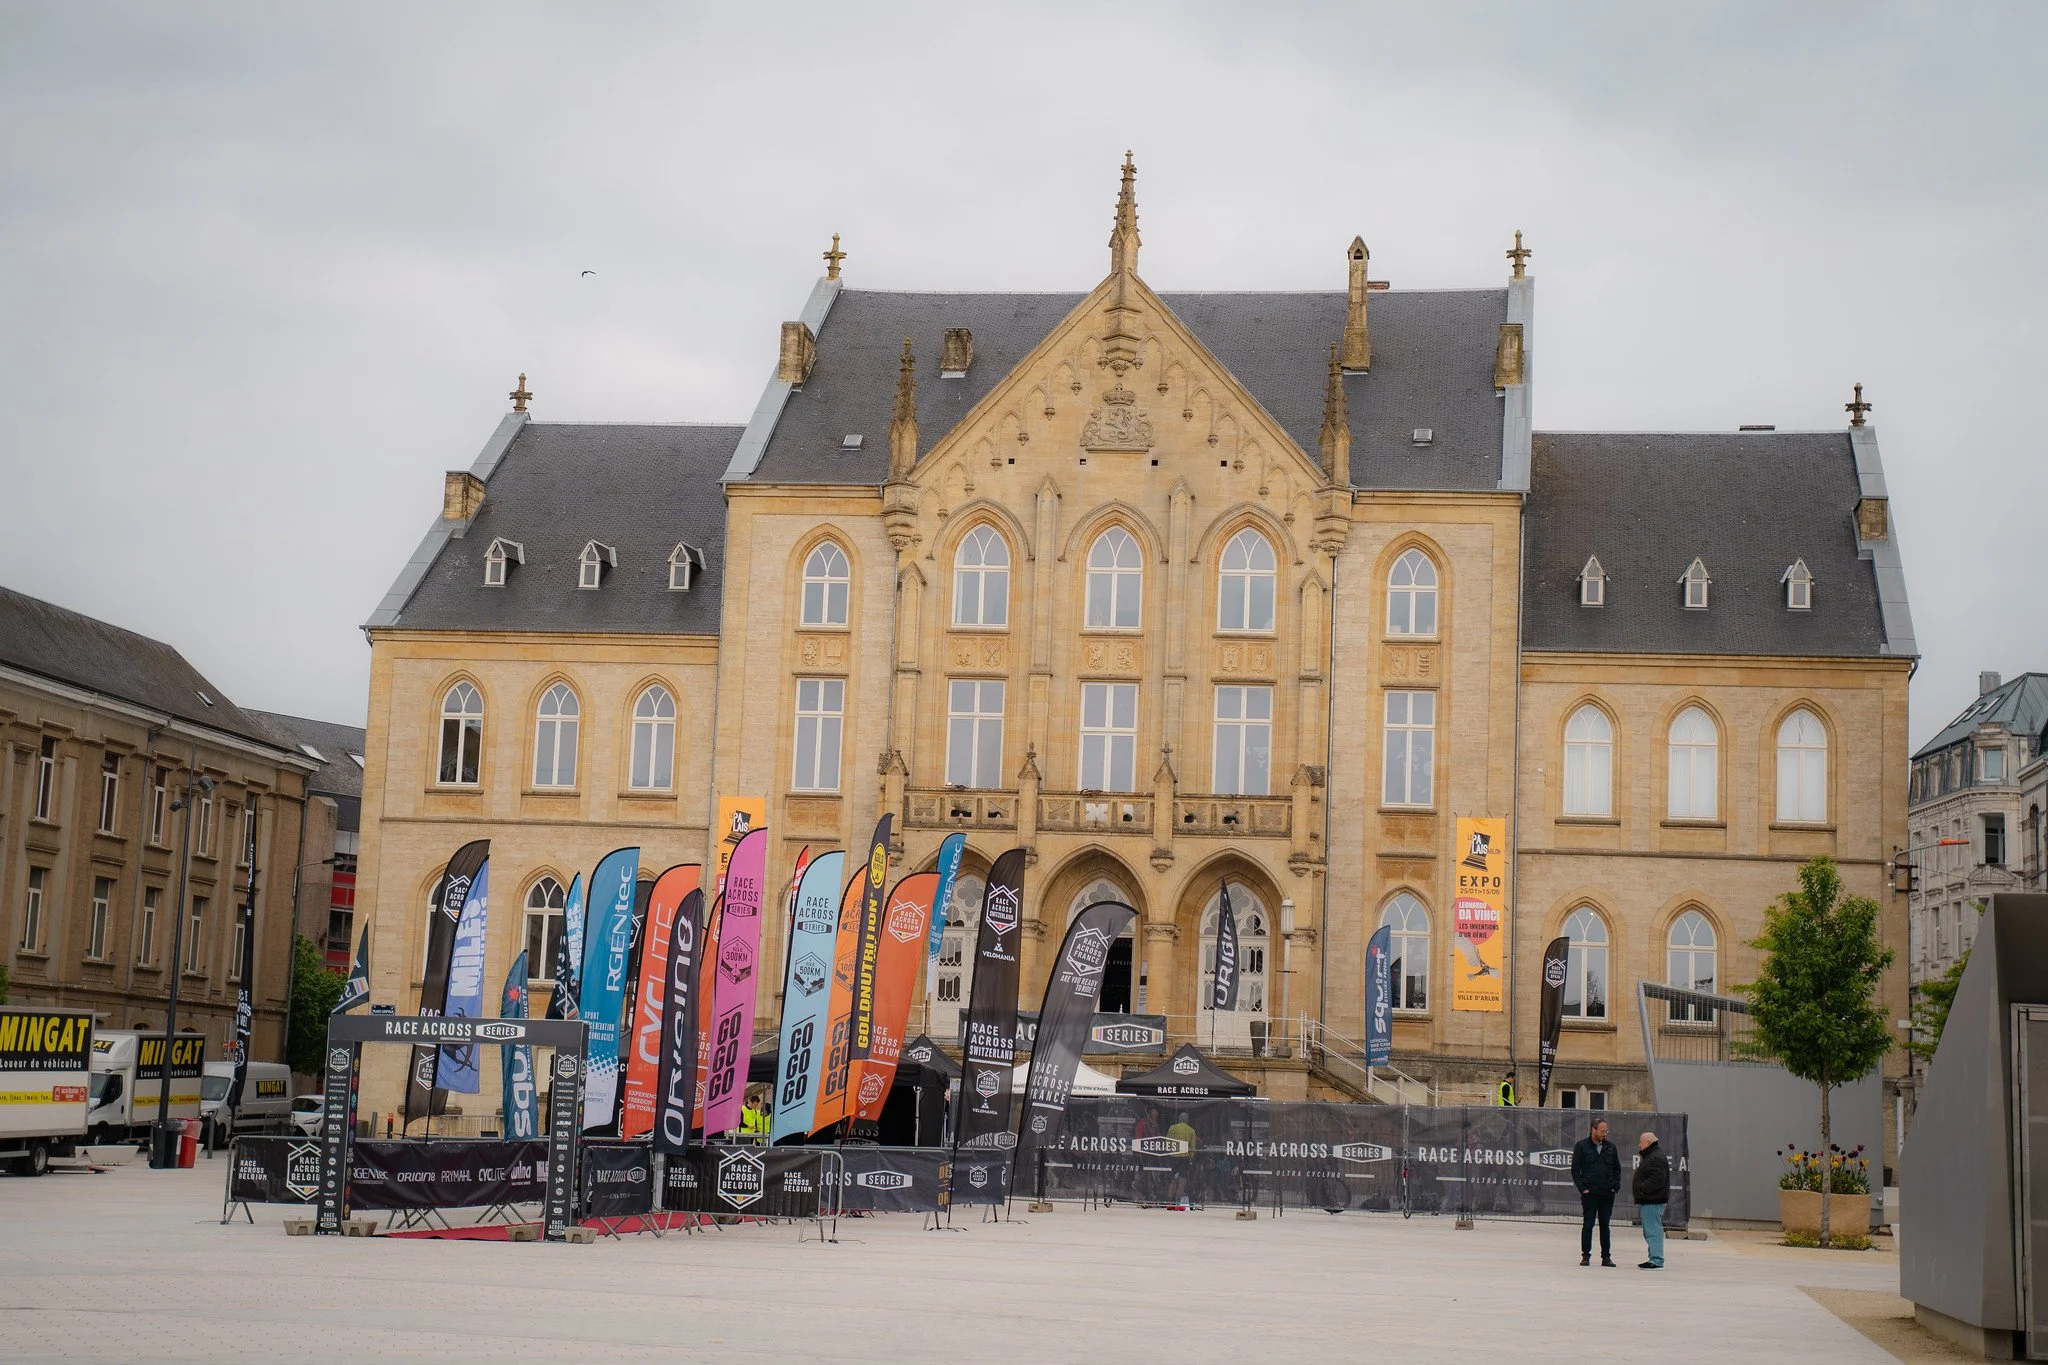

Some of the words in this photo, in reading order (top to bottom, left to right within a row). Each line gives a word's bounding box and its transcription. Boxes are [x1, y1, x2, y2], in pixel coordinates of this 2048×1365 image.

[733, 876, 754, 889] RACE
[1460, 876, 1501, 888] EXPO
[449, 893, 464, 901] ACRO
[727, 889, 759, 902] ACROSS
[995, 897, 1009, 906] RACE
[806, 896, 829, 909] RACE
[731, 905, 751, 914] SERIES
[799, 908, 834, 921] ACROSS
[901, 910, 916, 919] RACE
[991, 905, 1013, 914] ACROSS
[1459, 909, 1471, 920] DA
[1474, 909, 1500, 921] VINCI
[892, 921, 919, 931] BELGIUM
[895, 916, 919, 925] ACROSS
[804, 923, 825, 932] SERIES
[1470, 923, 1500, 931] INVENTIONS
[1083, 937, 1101, 950] RACE
[725, 951, 748, 962] 300KM
[982, 950, 1015, 962] VELOMANIA
[1076, 943, 1103, 958] ACROSS
[1073, 950, 1101, 965] FRANCE
[799, 966, 821, 976] 500KM
[1060, 975, 1072, 983] ARE
[1071, 976, 1082, 984] YOU
[1081, 978, 1099, 987] READY
[0, 1016, 90, 1052] MINGAT
[385, 1021, 417, 1035] RACE
[421, 1022, 472, 1037] ACROSS
[485, 1026, 516, 1036] SERIES
[717, 1011, 742, 1046] GO
[972, 1022, 999, 1036] RACE
[789, 1021, 814, 1054] GO
[970, 1034, 1014, 1049] ACROSS
[1106, 1028, 1149, 1043] SERIES
[712, 1039, 739, 1074] GO
[873, 1045, 900, 1058] LGIUM
[969, 1045, 1014, 1061] SWITZERLAND
[0, 1058, 27, 1068] Loueur
[30, 1058, 40, 1068] de
[43, 1058, 82, 1068] véhicules
[786, 1047, 811, 1080] GO
[258, 1081, 284, 1093] MINGAT
[708, 1066, 735, 1101] GO
[782, 1074, 808, 1106] GO
[1157, 1086, 1177, 1094] RACE
[1180, 1086, 1209, 1095] ACROSS
[627, 1097, 653, 1105] FREEDOM
[999, 1135, 1015, 1146] SERIES
[1070, 1136, 1127, 1152] ACROSS
[1143, 1140, 1178, 1152] SERIES
[1226, 1140, 1263, 1157] RACE
[1268, 1142, 1328, 1159] ACROSS
[1345, 1147, 1380, 1159] SERIES
[300, 1157, 320, 1165] RACE
[1418, 1147, 1458, 1163] RACE
[1463, 1148, 1524, 1166] ACROSS
[1543, 1153, 1573, 1165] SERIE
[294, 1165, 320, 1173] ACROS
[730, 1164, 752, 1173] RACE
[1105, 1164, 1140, 1172] CYCLING
[291, 1173, 320, 1181] BELGIU
[724, 1172, 757, 1182] ACROSS
[868, 1174, 901, 1186] SERIES
[1306, 1171, 1341, 1179] CYCLING
[722, 1180, 759, 1191] BELGIUM
[784, 1178, 809, 1186] ACROSS
[1501, 1178, 1539, 1186] CYCLING
[783, 1185, 813, 1193] BELGIUM
